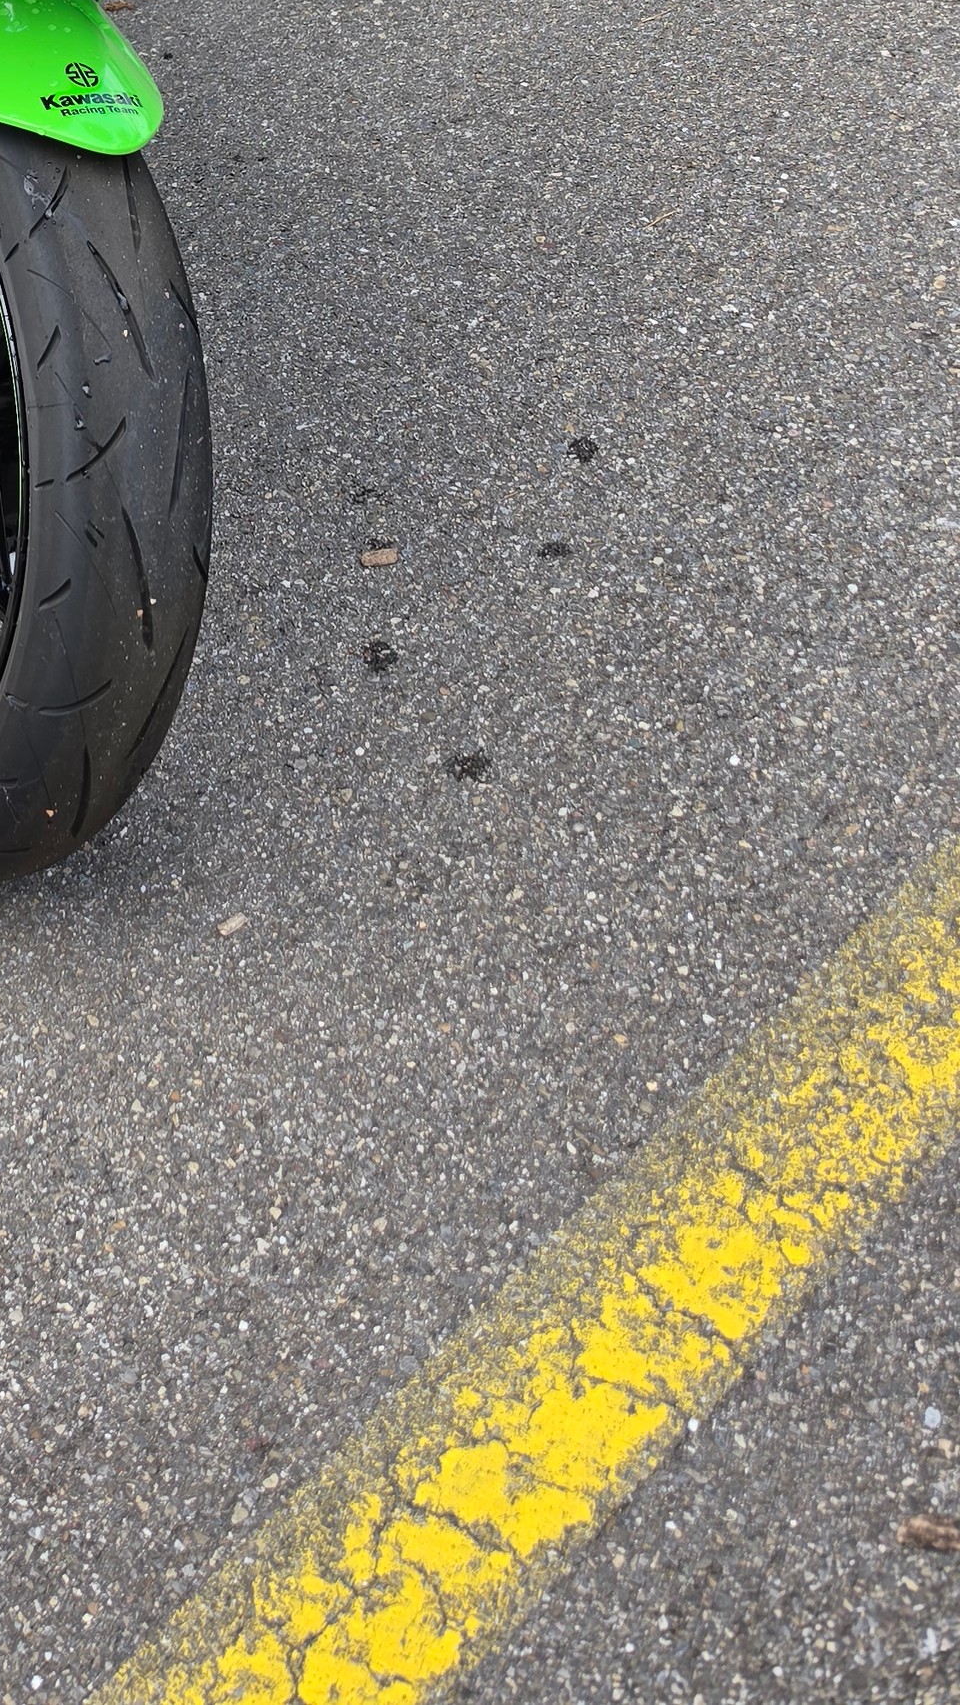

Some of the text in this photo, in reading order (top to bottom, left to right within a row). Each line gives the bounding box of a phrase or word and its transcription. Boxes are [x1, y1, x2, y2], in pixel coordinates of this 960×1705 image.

[40, 92, 144, 110] Kawasaki
[60, 105, 139, 117] Racing Team
